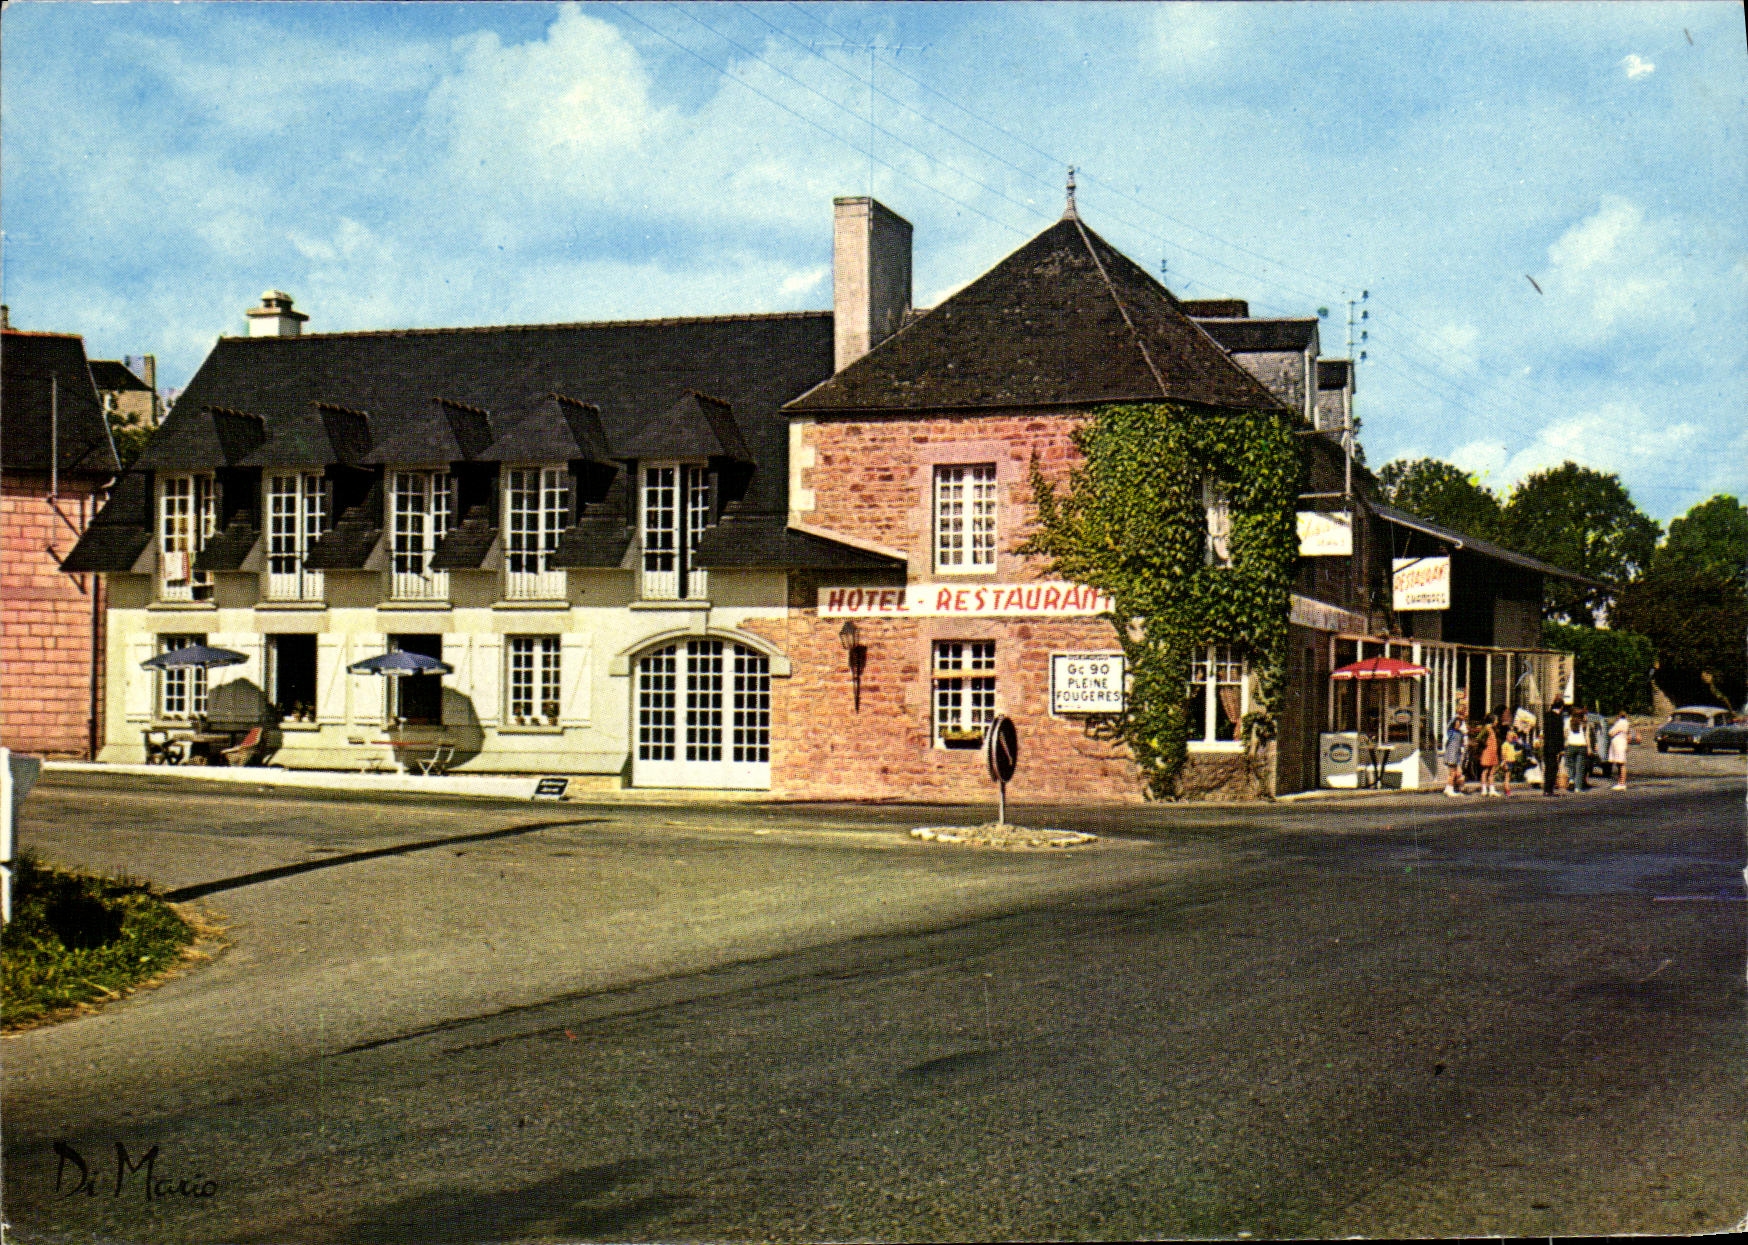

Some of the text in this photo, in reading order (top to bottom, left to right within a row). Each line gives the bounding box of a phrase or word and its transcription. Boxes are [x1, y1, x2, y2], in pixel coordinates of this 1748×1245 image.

[828, 588, 911, 612] HOTEL
[1089, 663, 1110, 675] 90
[1067, 677, 1108, 689] PLEINE
[1056, 690, 1120, 702] FOUGERES
